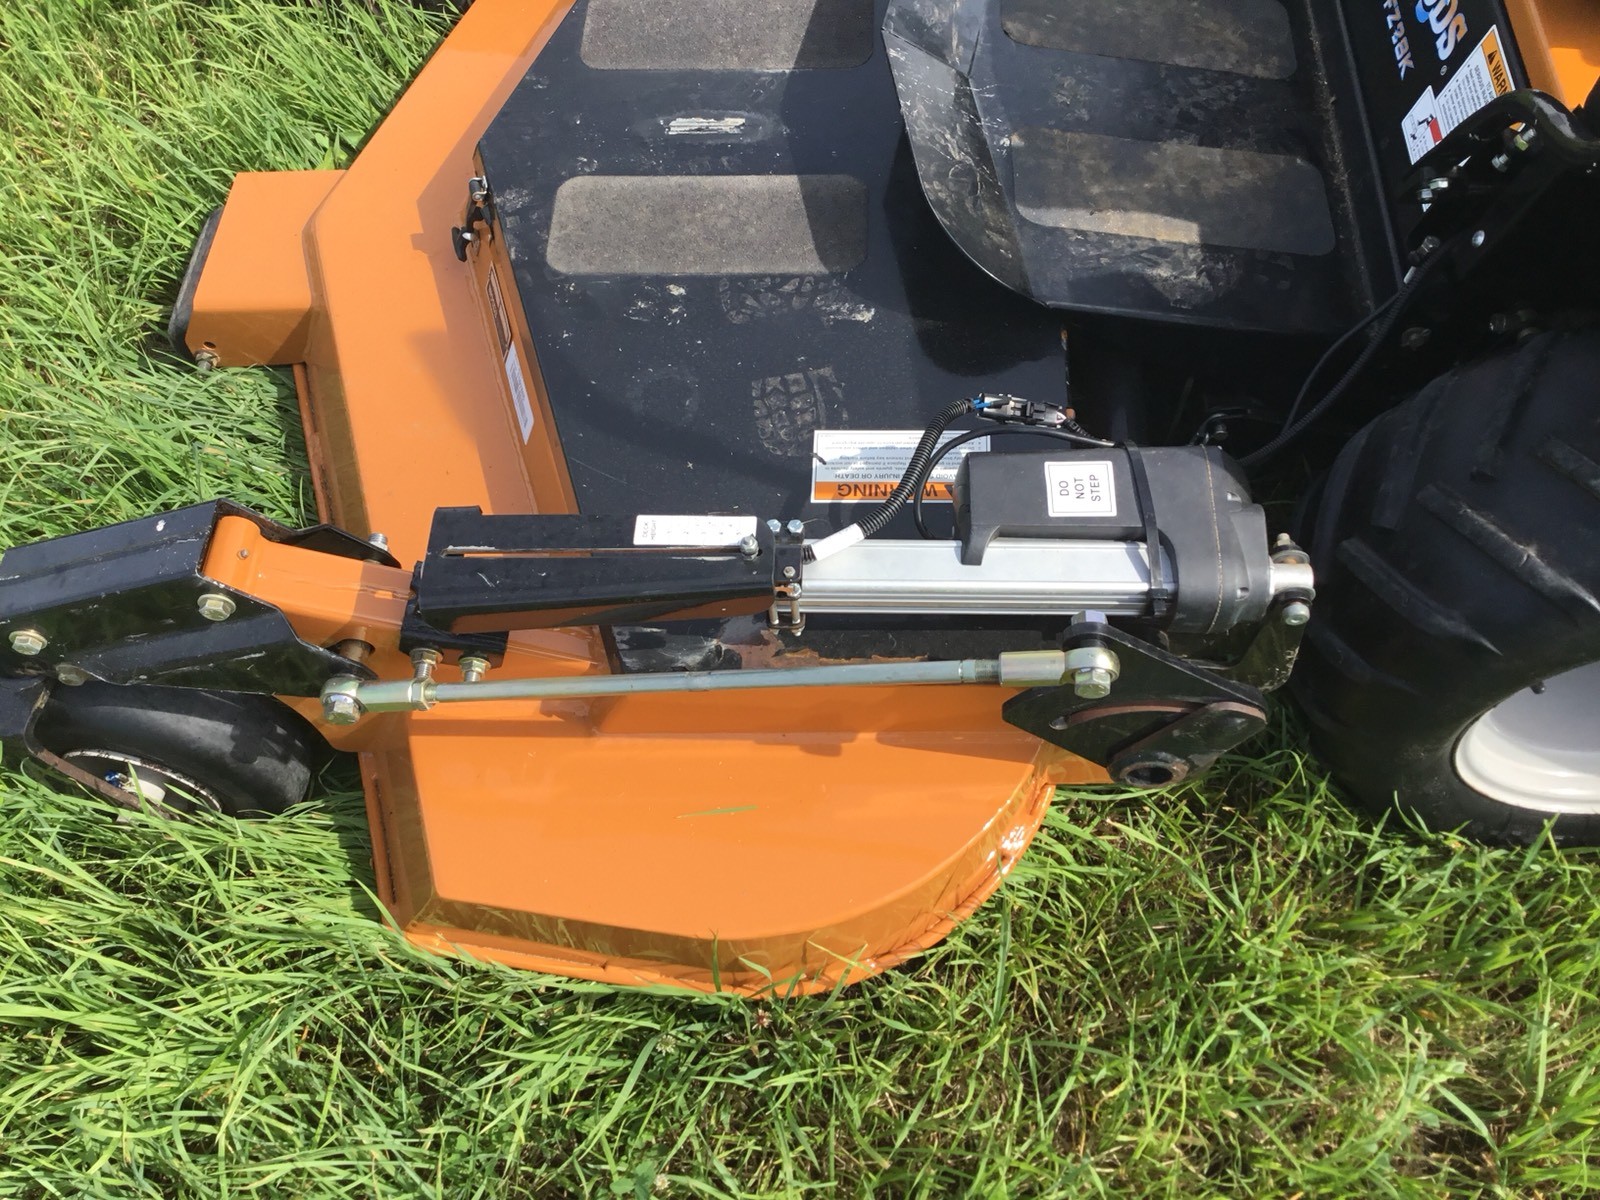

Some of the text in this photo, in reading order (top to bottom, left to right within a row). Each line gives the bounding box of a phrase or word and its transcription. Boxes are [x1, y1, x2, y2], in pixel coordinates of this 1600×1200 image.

[837, 482, 938, 497] WRNING
[1058, 480, 1070, 496] DO
[1073, 477, 1085, 499] NOT
[1089, 474, 1102, 502] STEP
